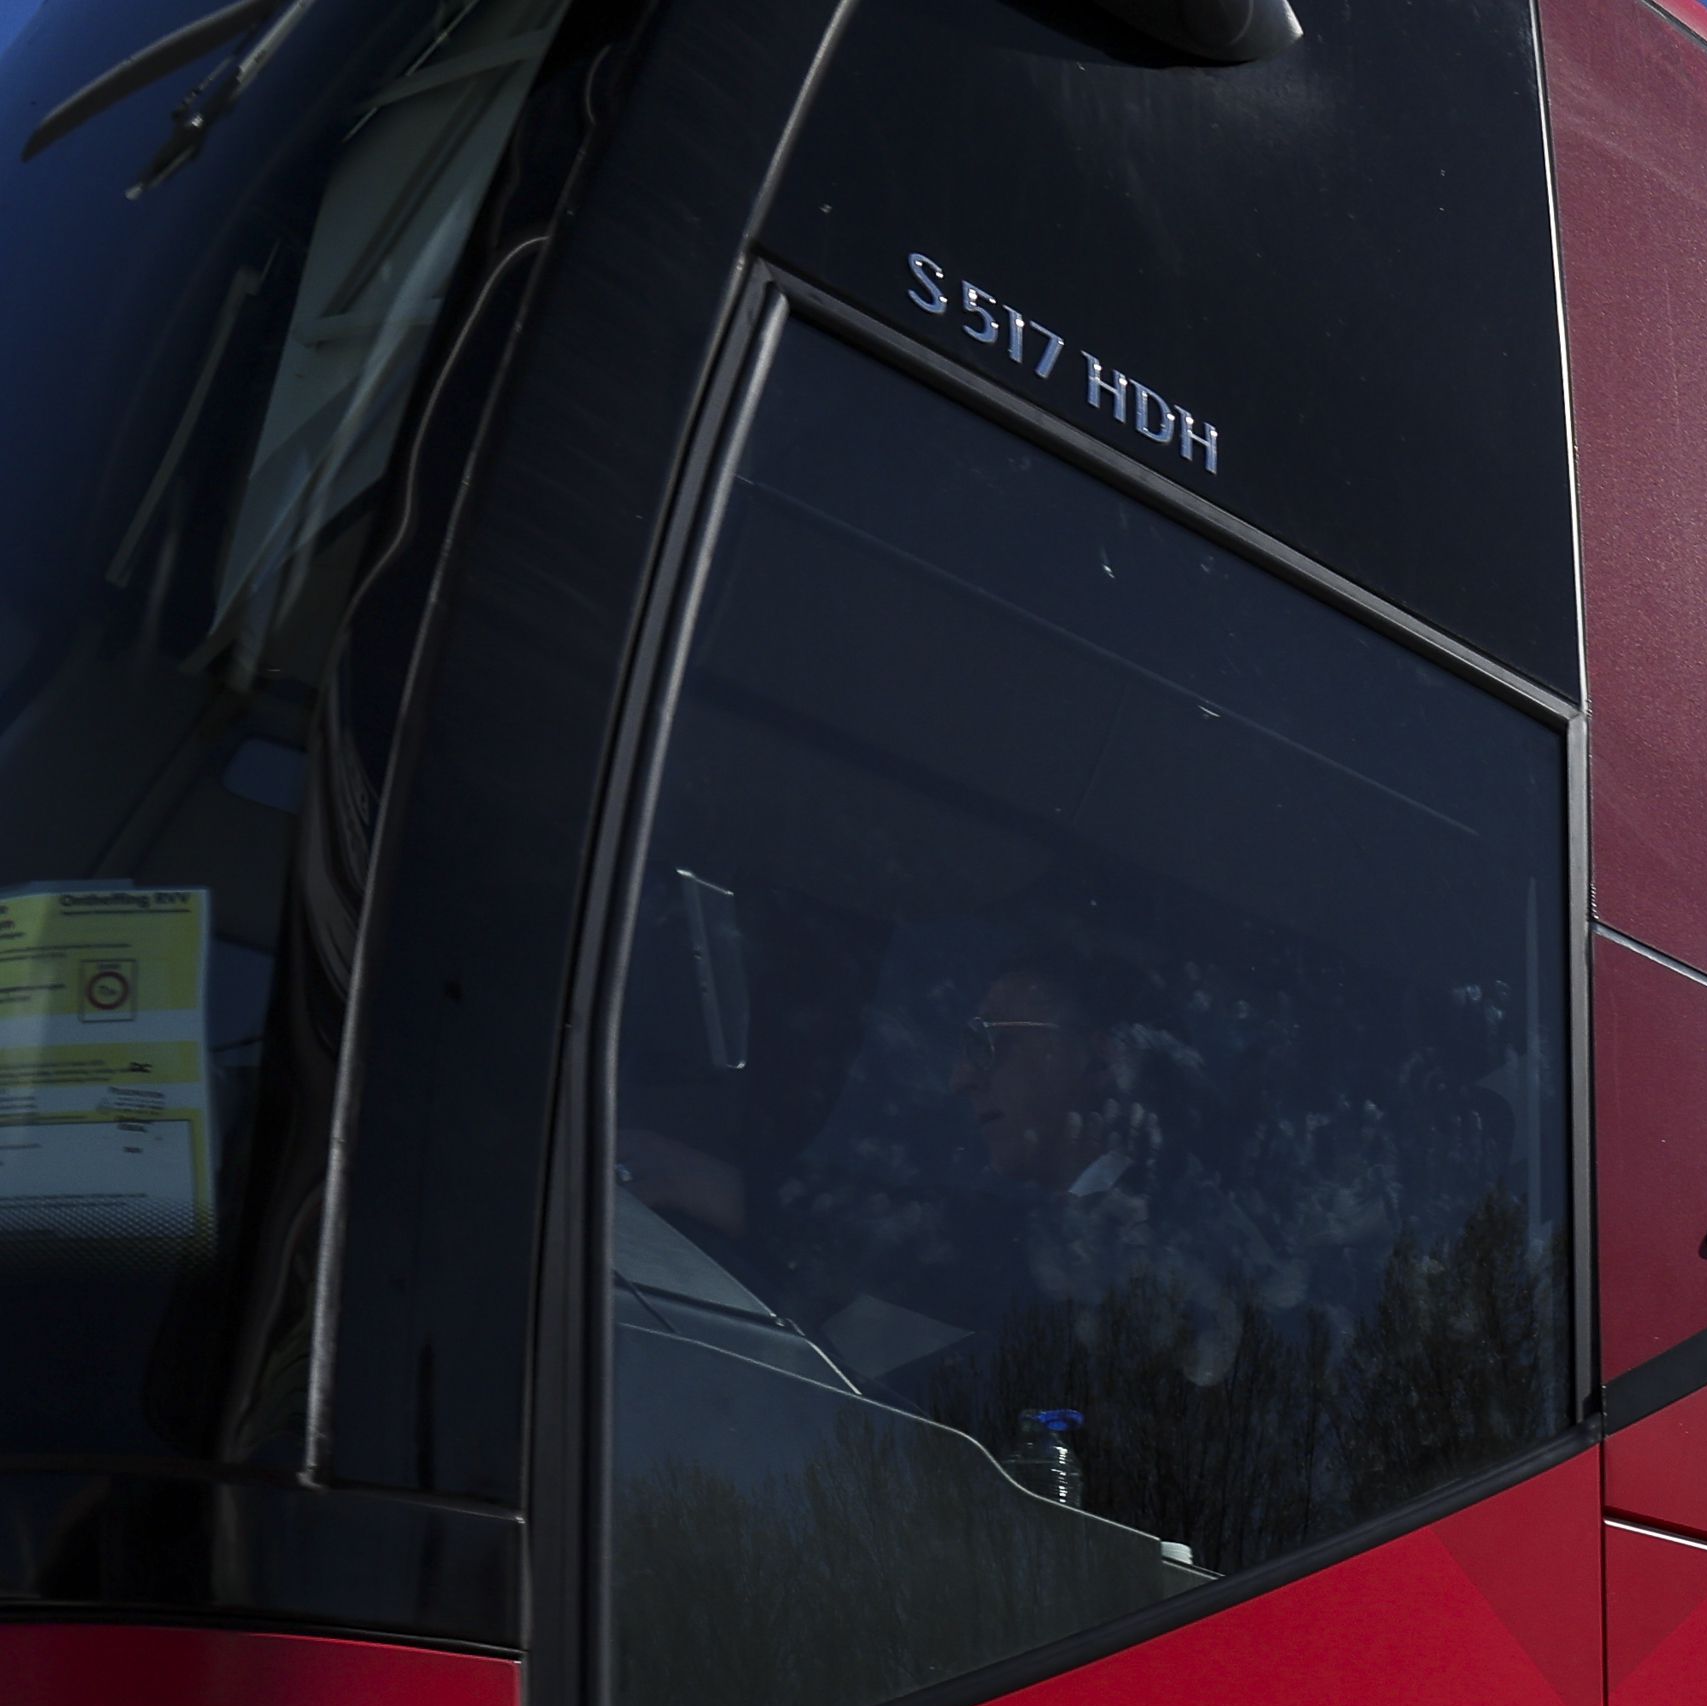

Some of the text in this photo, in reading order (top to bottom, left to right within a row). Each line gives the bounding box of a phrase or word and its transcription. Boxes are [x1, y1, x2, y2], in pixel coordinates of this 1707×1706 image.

[908, 252, 1218, 474] S 517 HDH
